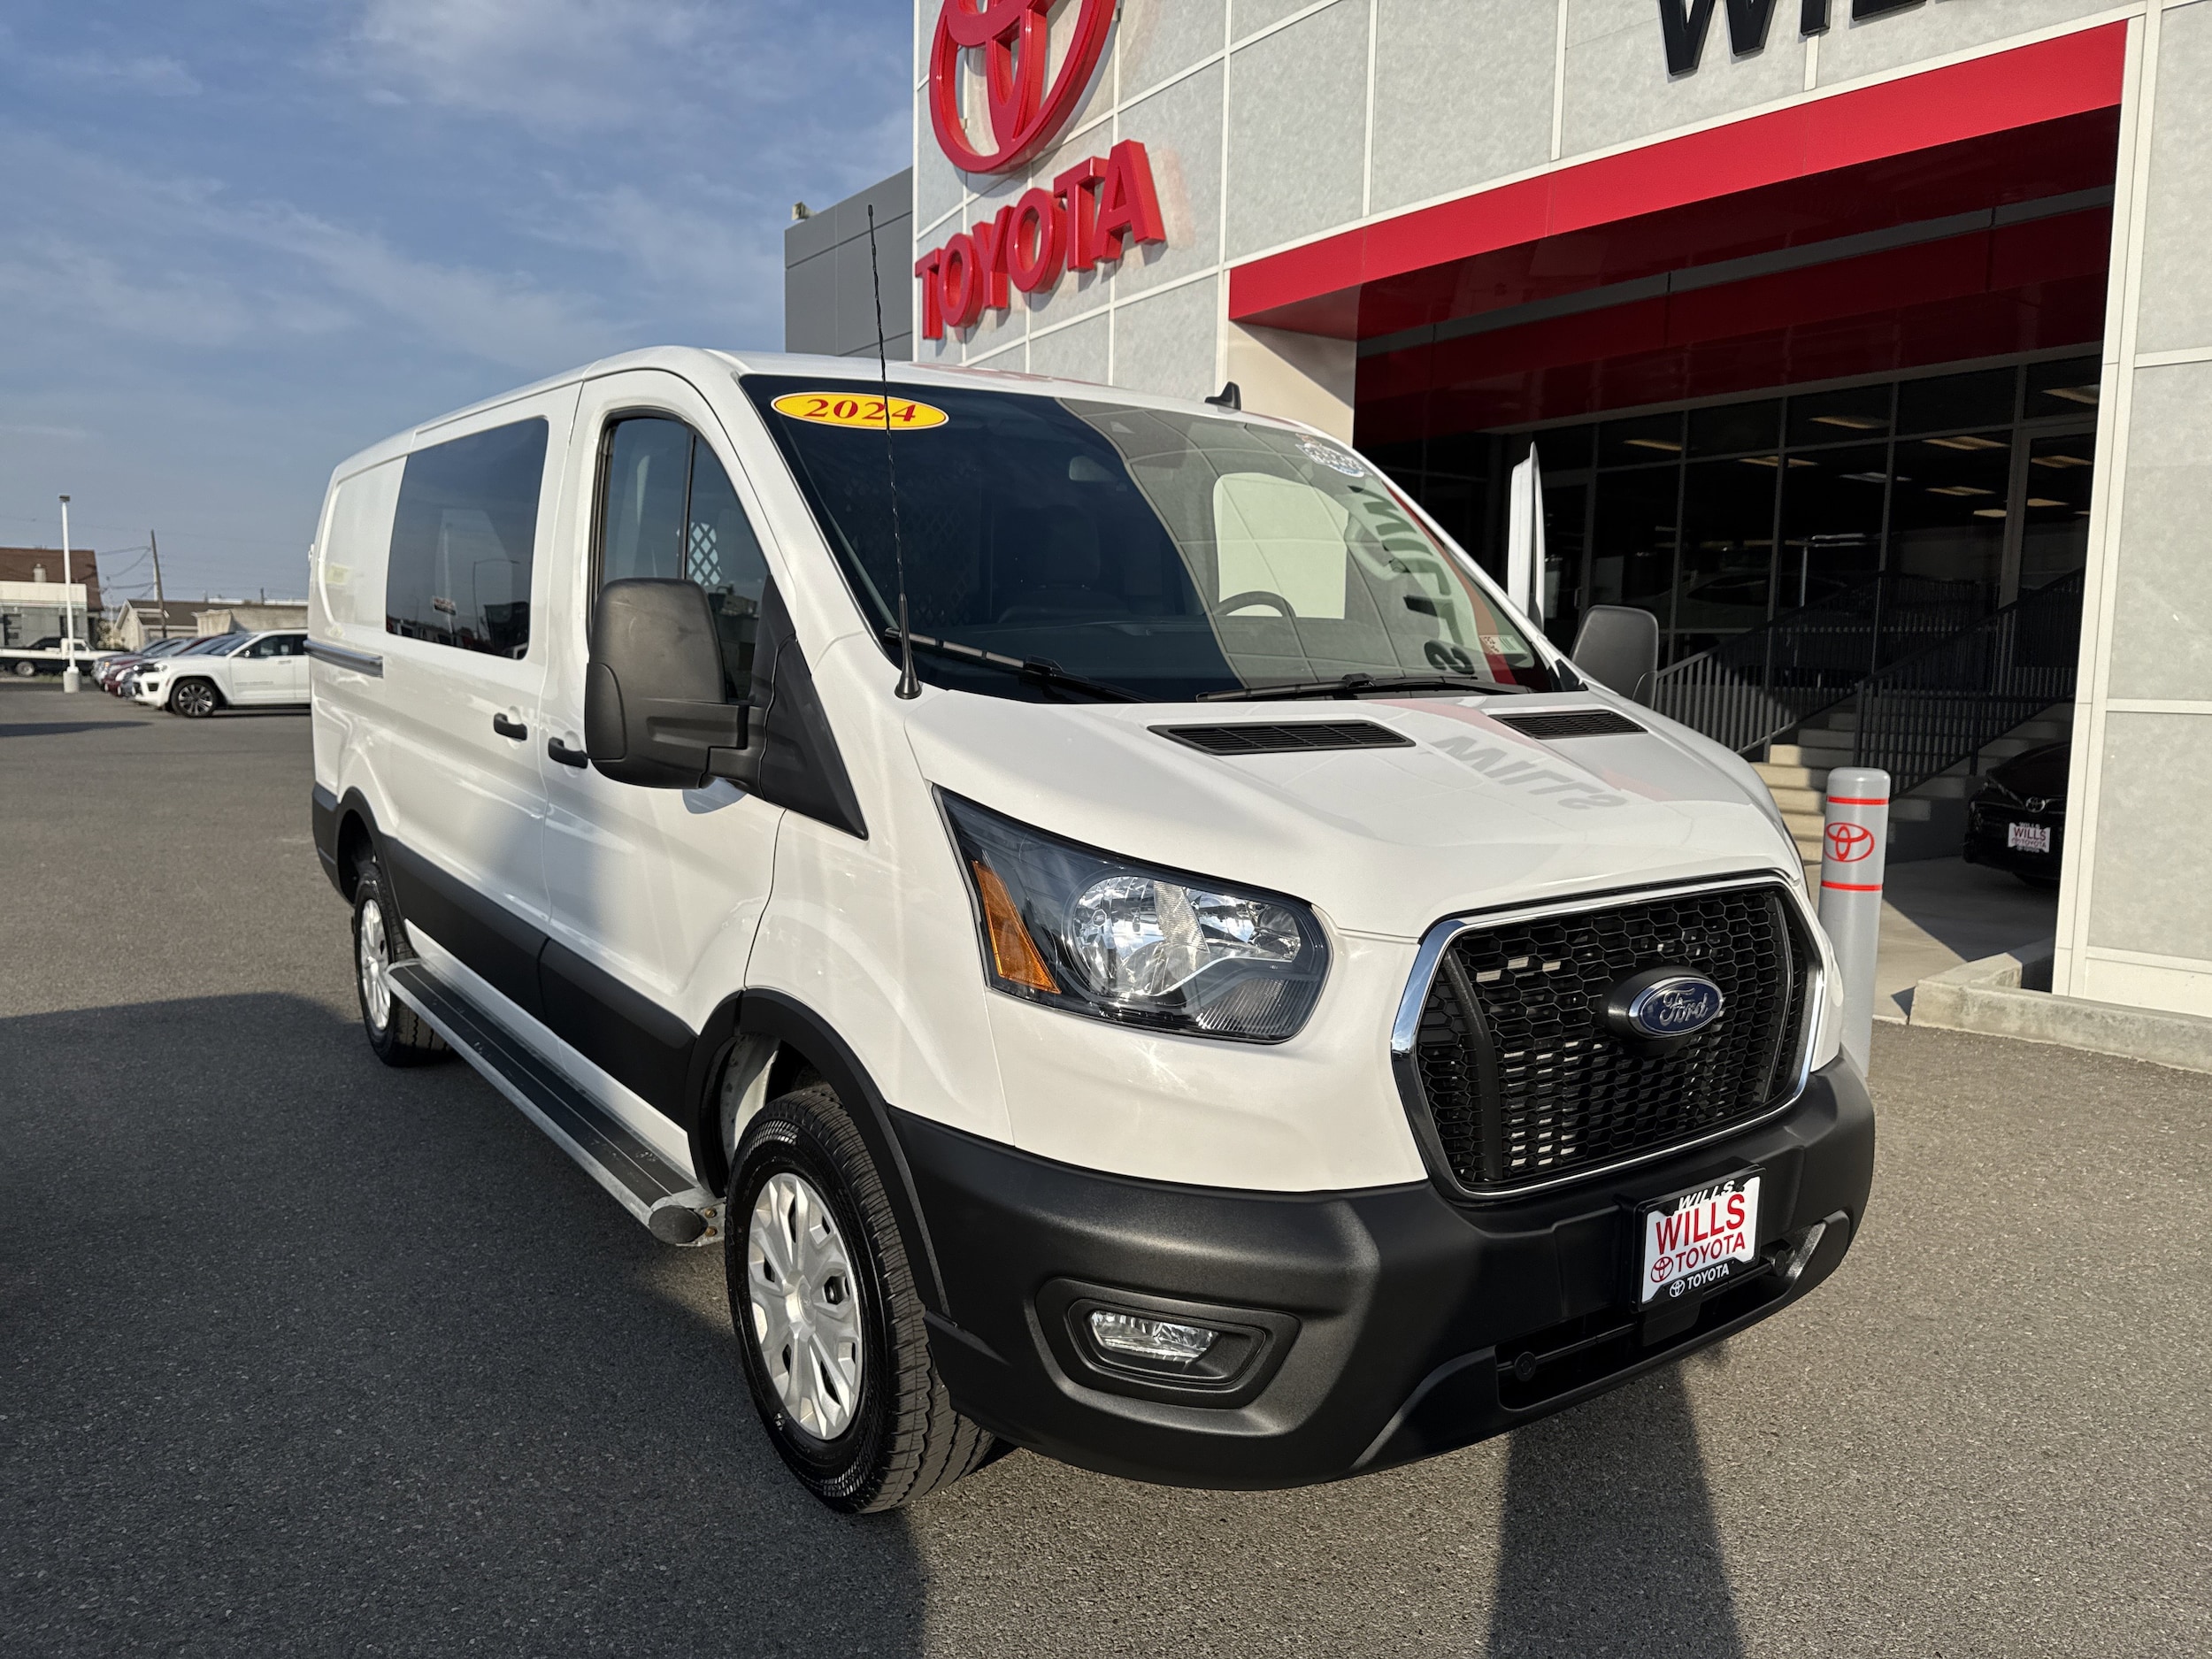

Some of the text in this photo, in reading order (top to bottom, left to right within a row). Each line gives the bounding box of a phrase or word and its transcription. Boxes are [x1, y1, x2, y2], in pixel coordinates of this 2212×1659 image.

[915, 139, 1166, 340] TOYOTA
[803, 399, 917, 422] 2024
[2014, 826, 2047, 841] WILLS
[1659, 987, 1709, 1026] Ford
[1678, 1180, 1735, 1211] WILLS
[1655, 1194, 1746, 1255] WILLS
[1675, 1232, 1746, 1272] TOYOTA
[1686, 1263, 1730, 1290] TOYOTA
